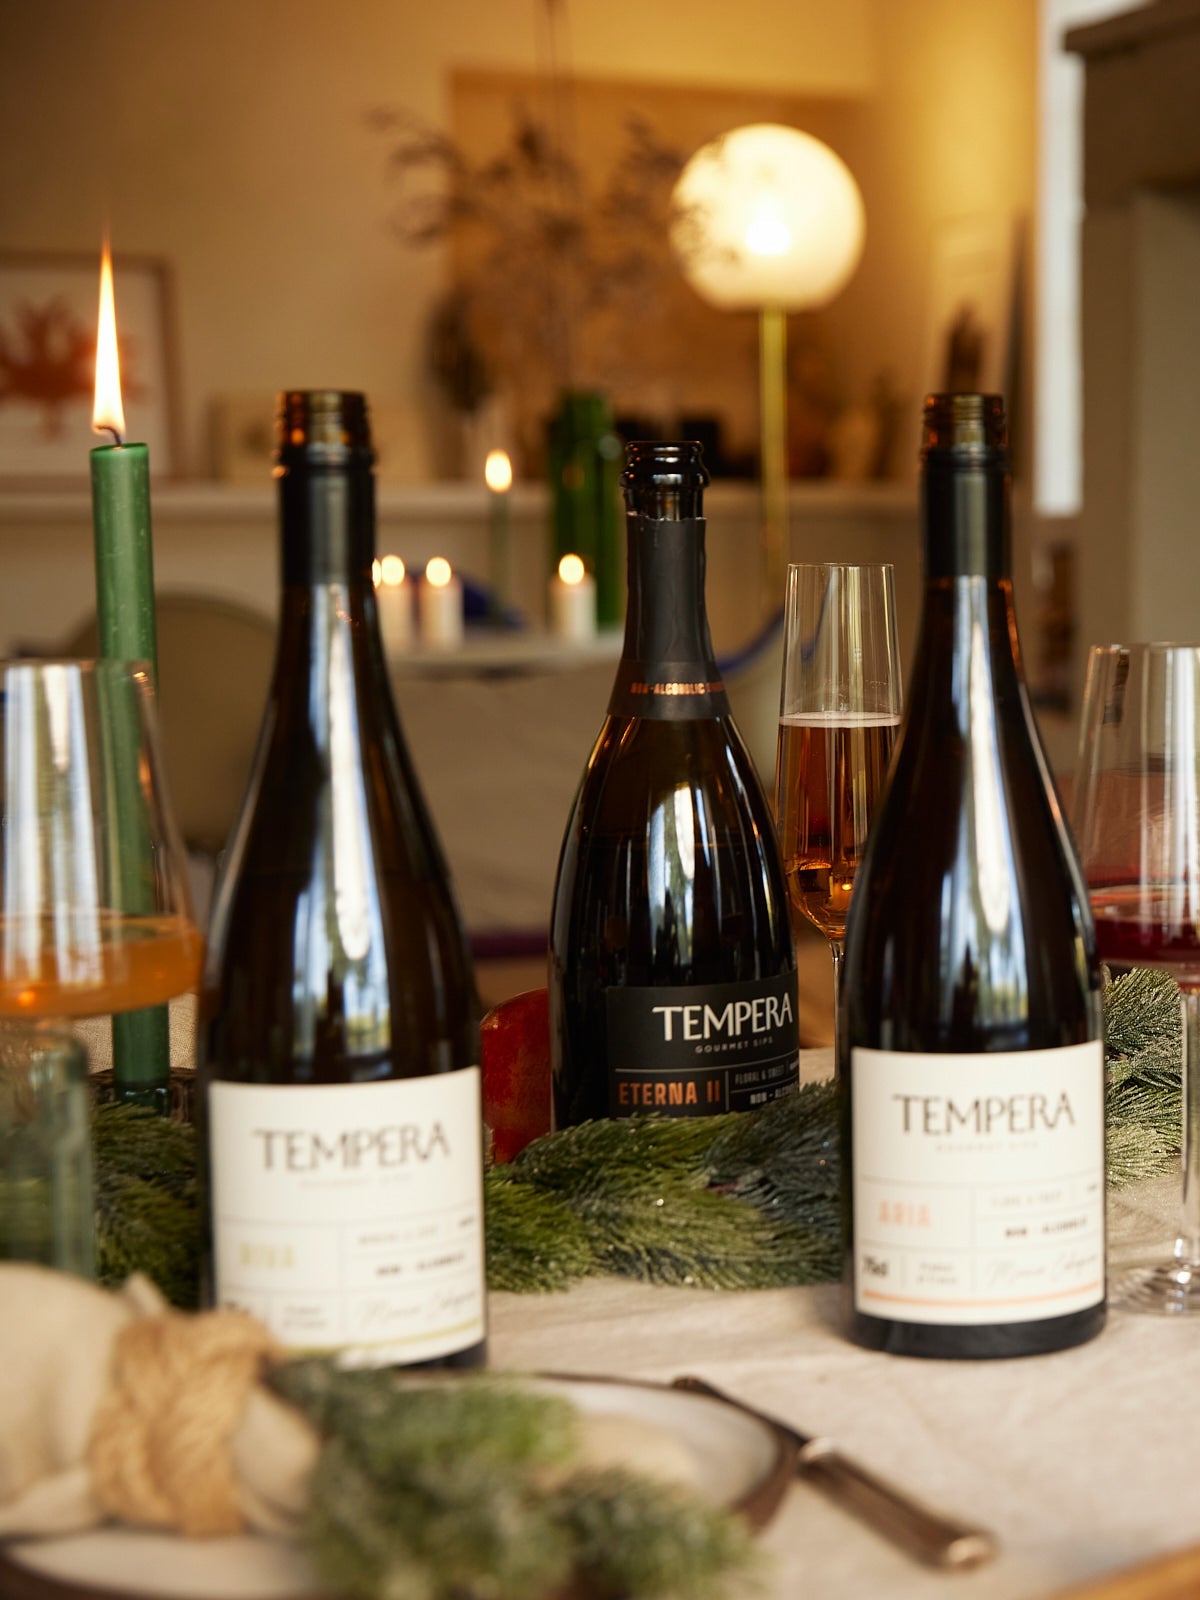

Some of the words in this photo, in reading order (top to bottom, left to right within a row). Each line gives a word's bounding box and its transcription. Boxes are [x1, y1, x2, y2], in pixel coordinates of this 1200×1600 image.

[652, 992, 793, 1041] TEMPERA
[695, 1041, 749, 1054] GOURMET
[618, 1080, 698, 1106] ETERNA
[707, 1079, 721, 1103] II
[891, 1091, 1076, 1136] TEMPERA
[253, 1121, 451, 1171] TEMPERA
